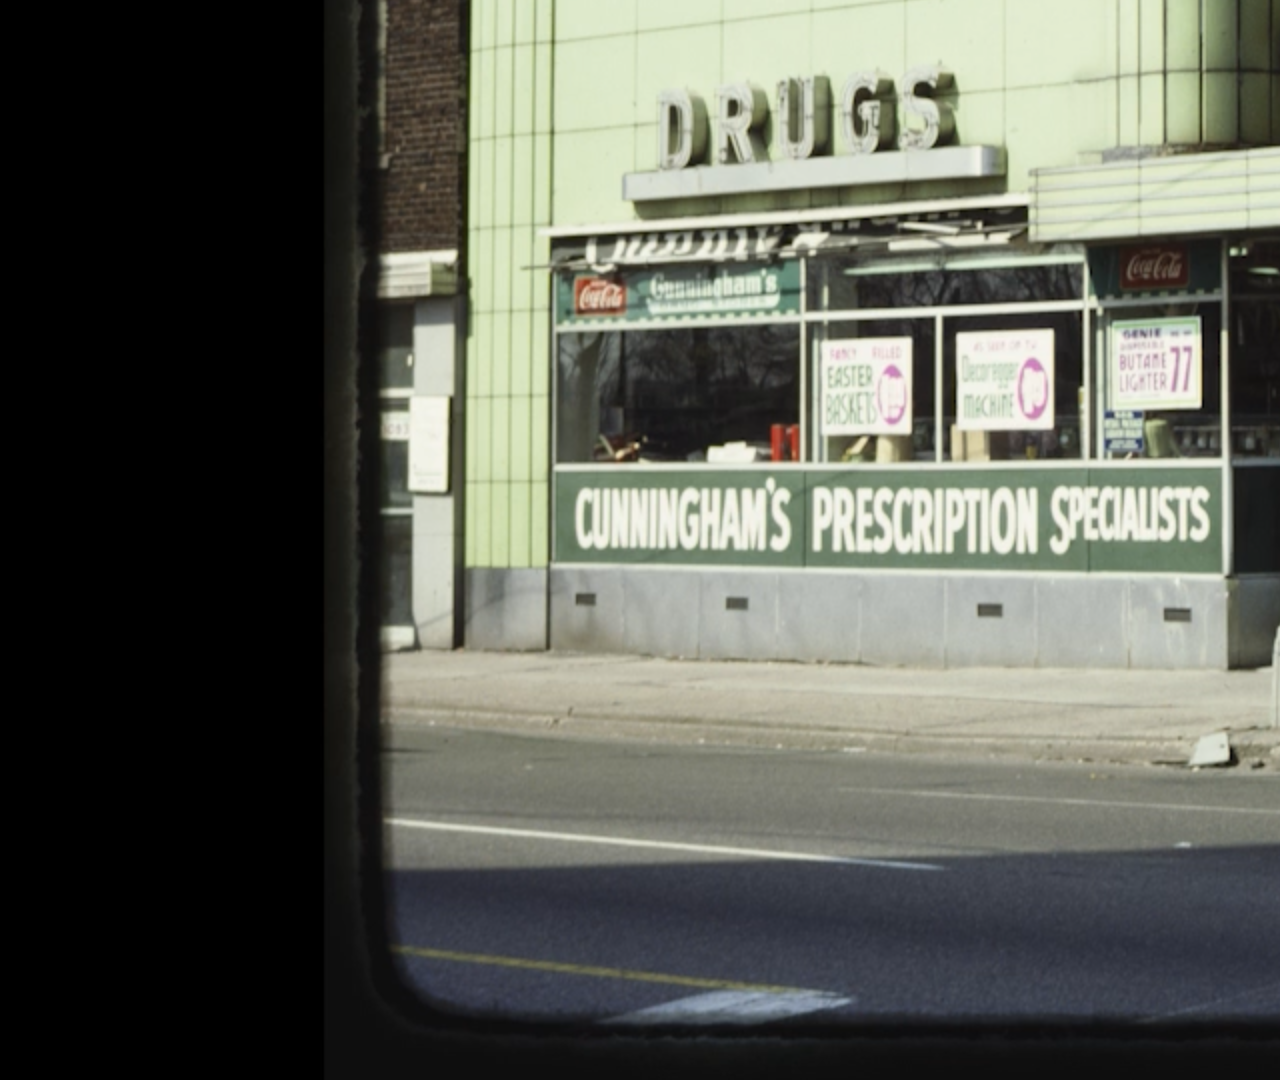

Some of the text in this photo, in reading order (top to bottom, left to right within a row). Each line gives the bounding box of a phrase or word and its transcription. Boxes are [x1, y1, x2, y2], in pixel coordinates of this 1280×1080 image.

[657, 62, 958, 170] DRUGS
[1122, 327, 1162, 339] GENIE
[1120, 353, 1167, 371] BUTANE
[1170, 346, 1193, 392] 77
[827, 365, 873, 388] EASTER
[1120, 373, 1168, 392] LIGHTER
[826, 391, 877, 425] BASKETS
[575, 477, 1211, 555] CUNNINGHAM'S PRESCRIPTION SPECIALISTS
